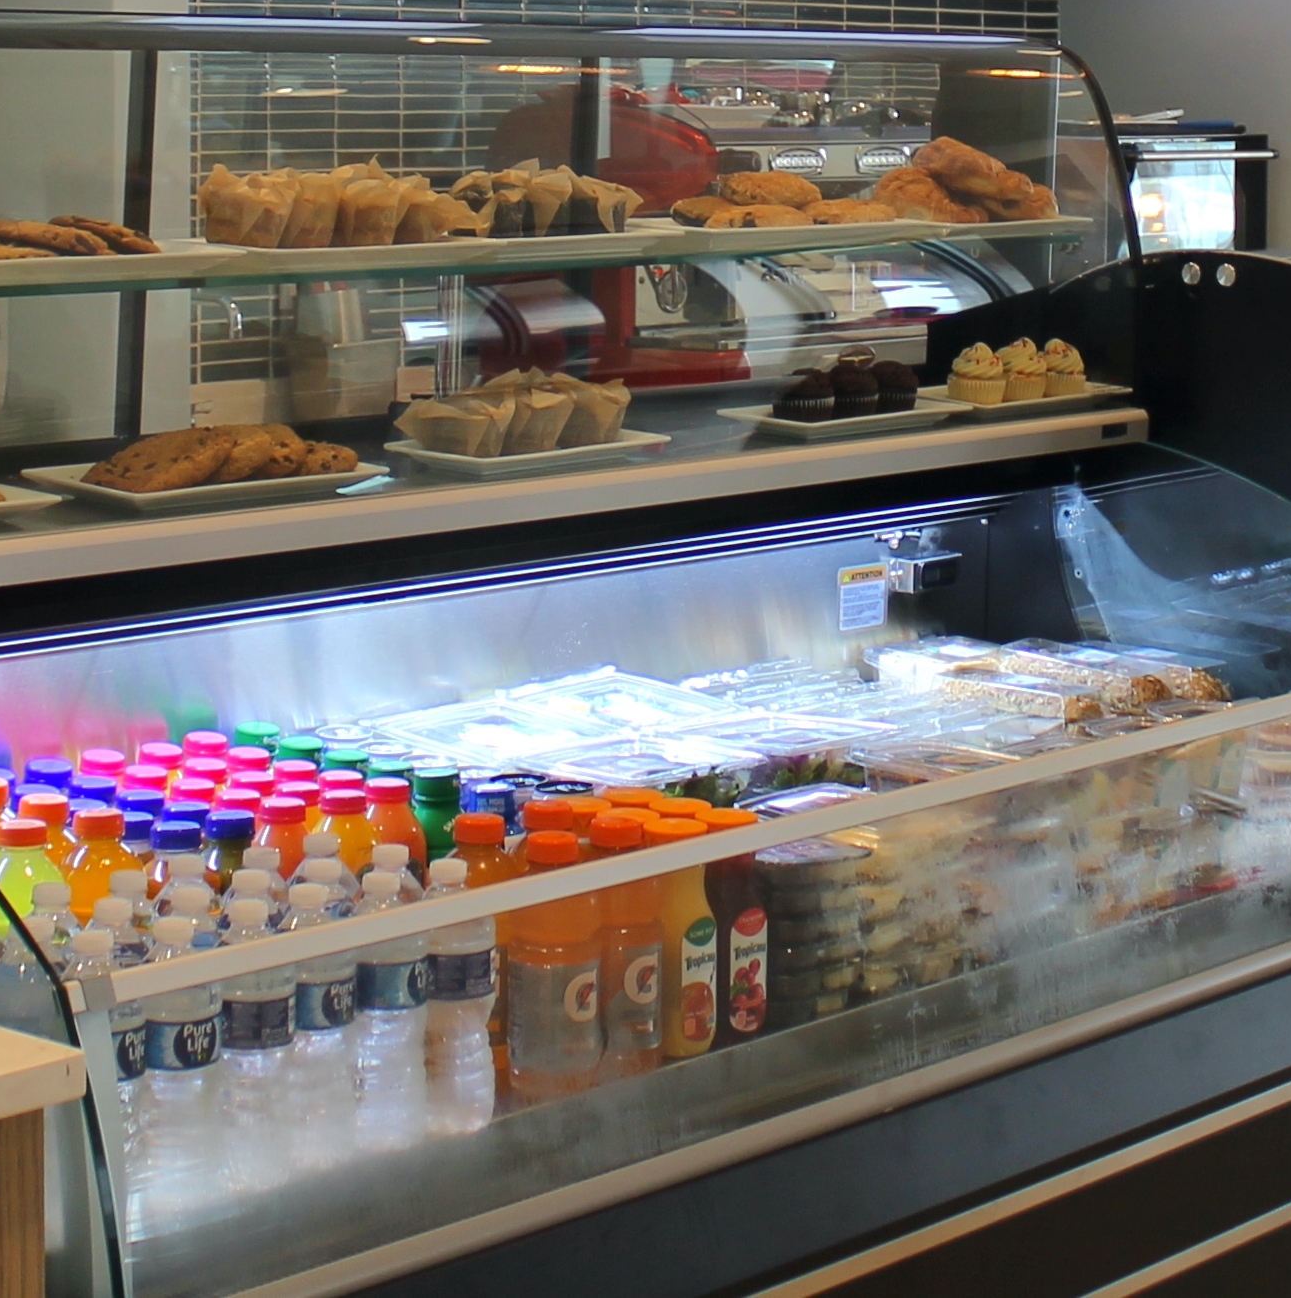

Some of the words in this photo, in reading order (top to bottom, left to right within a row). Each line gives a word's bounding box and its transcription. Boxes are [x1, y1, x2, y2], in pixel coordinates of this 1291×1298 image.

[125, 1030, 146, 1047] Pur
[184, 1022, 213, 1039] Pure
[187, 1036, 210, 1055] Life
